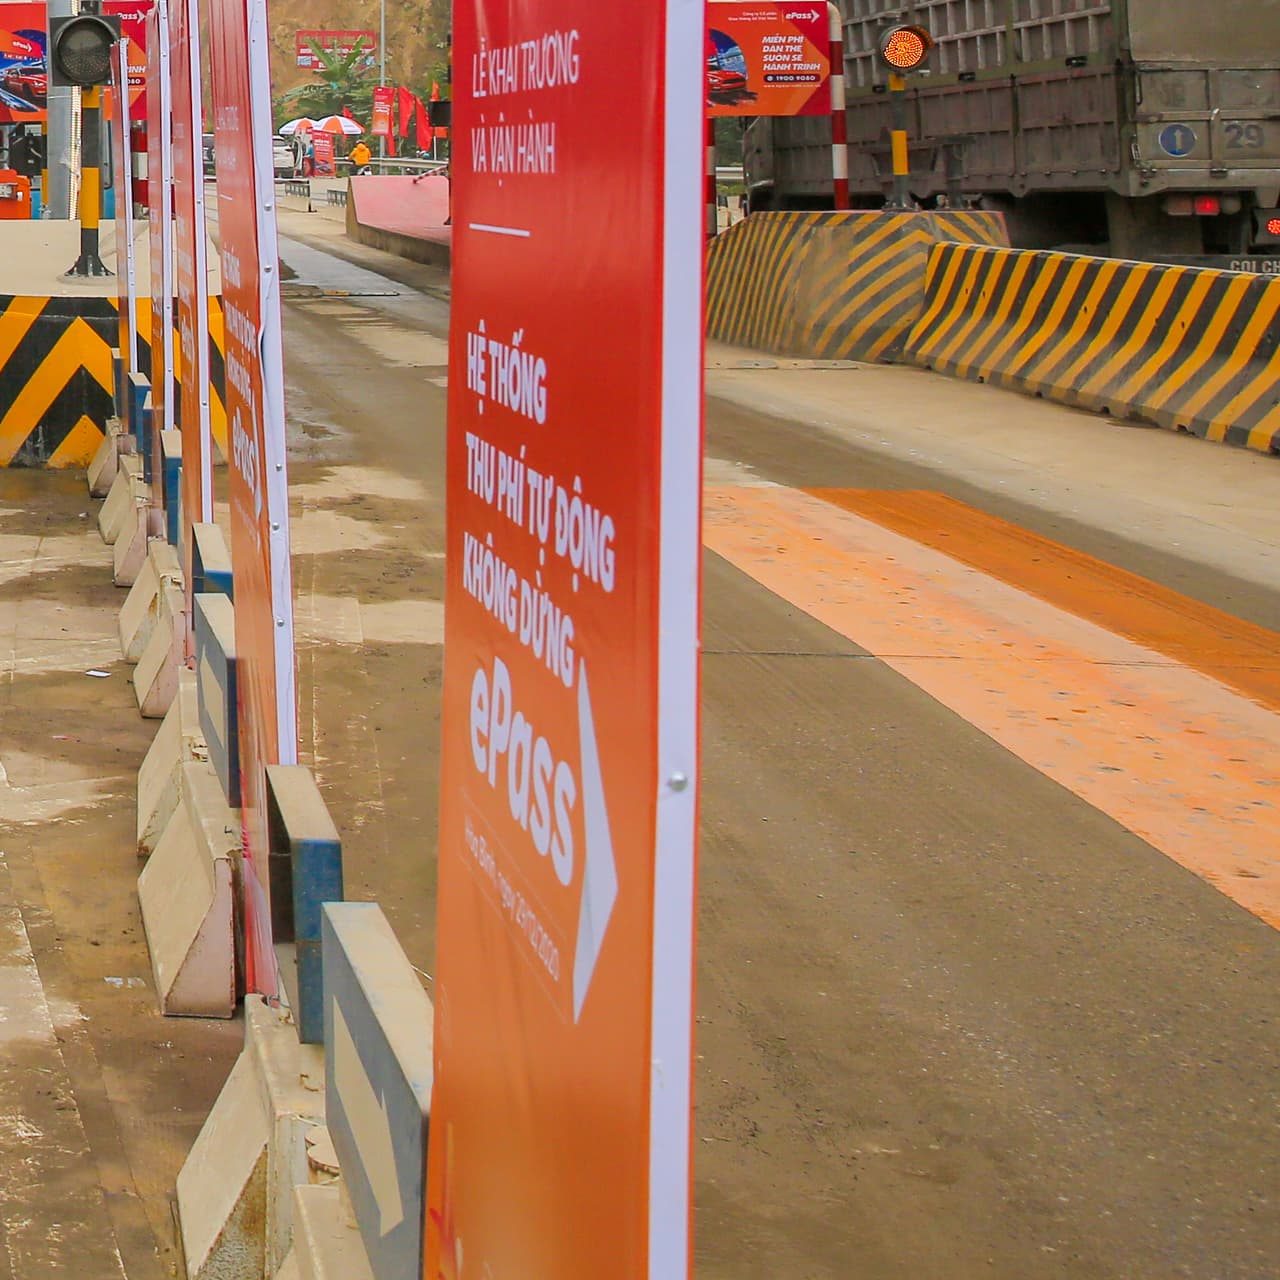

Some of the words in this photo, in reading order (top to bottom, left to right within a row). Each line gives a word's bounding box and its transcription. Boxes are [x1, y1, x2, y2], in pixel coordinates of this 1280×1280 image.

[488, 44, 518, 96] KHAI
[520, 29, 580, 91] TRƯƠNG
[471, 113, 487, 173] VÀ
[490, 111, 515, 187] VẬN
[517, 108, 556, 174] HÀNH
[1224, 124, 1265, 149] 29
[467, 319, 487, 415] HỆ
[488, 328, 548, 425] THỐNG
[466, 431, 494, 505] THU
[497, 445, 527, 527] PHÍ
[527, 468, 554, 566] TỰ
[554, 475, 616, 593] ĐỘNG
[463, 531, 517, 634] KHÔNG
[519, 569, 575, 688] DỪNG
[470, 655, 577, 887] ePass
